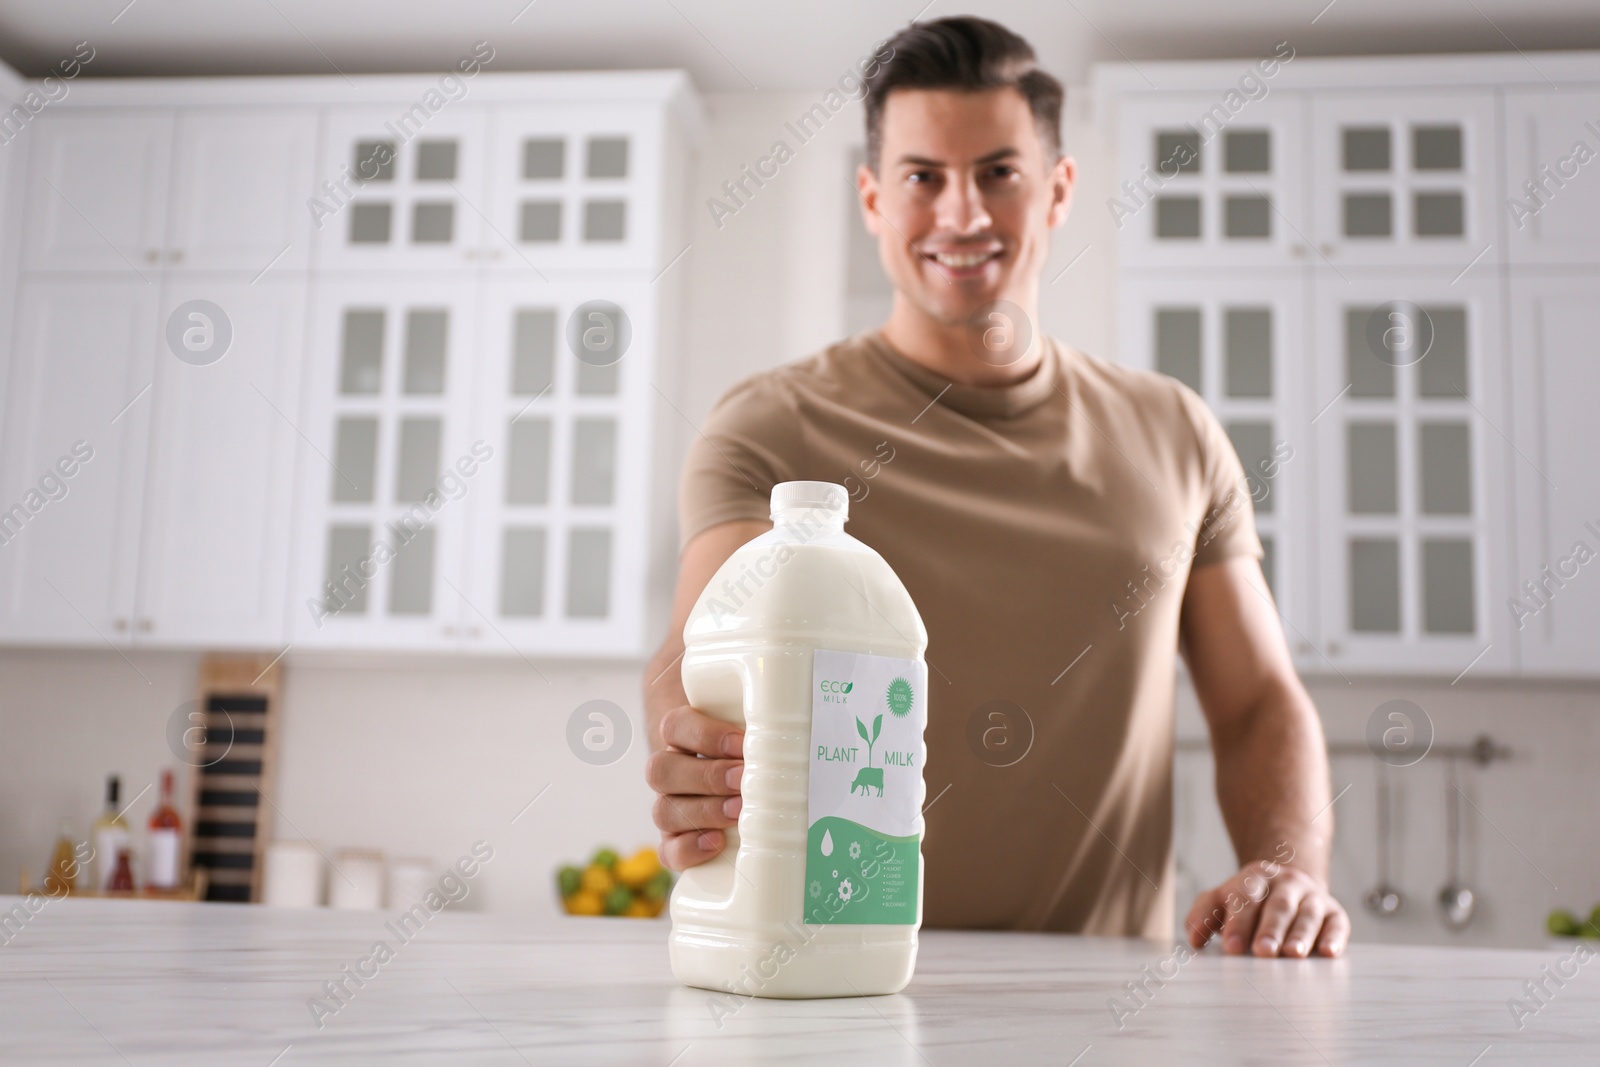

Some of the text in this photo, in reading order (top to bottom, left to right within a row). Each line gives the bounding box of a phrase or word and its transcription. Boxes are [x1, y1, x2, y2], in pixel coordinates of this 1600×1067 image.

[820, 679, 853, 695] ECO
[823, 695, 848, 704] MILK
[817, 745, 914, 767] PLANT MILK
